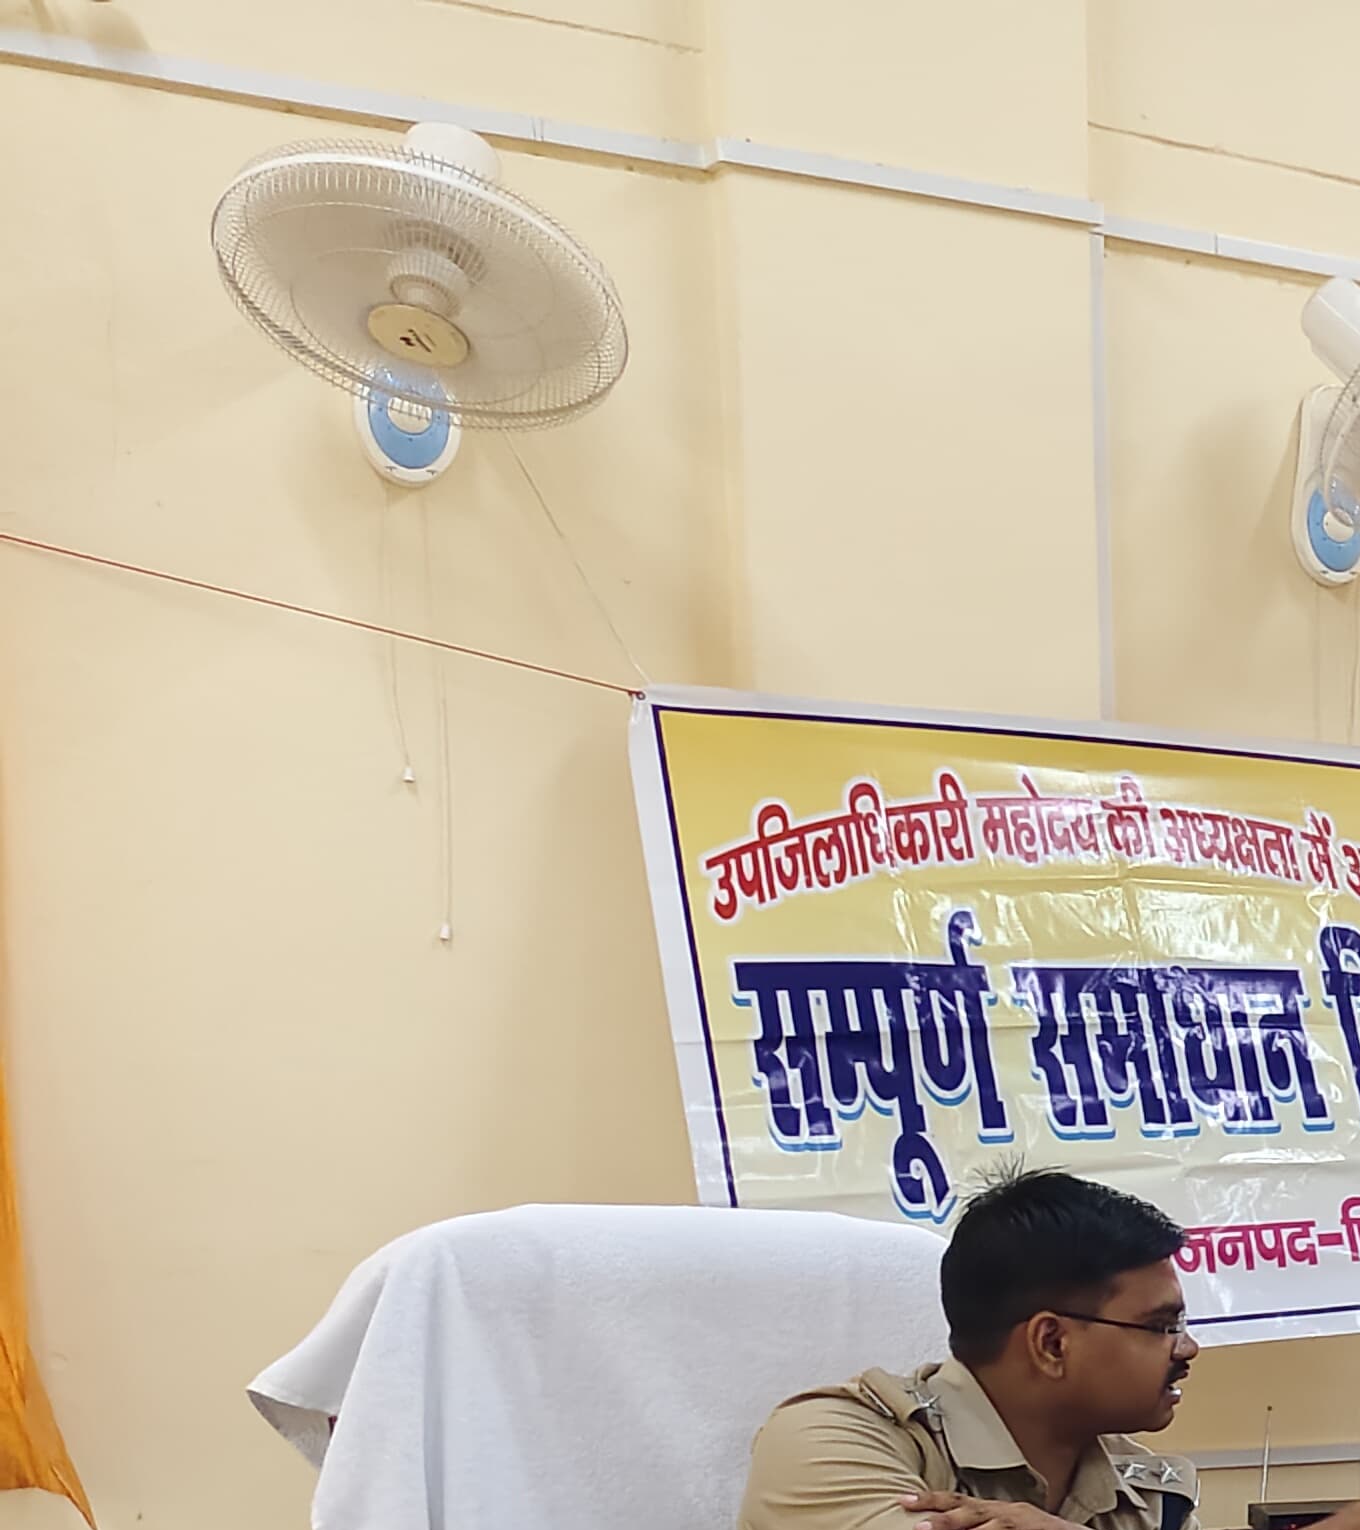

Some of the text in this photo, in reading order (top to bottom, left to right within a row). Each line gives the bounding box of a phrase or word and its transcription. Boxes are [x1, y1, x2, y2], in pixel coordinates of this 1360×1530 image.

[706, 773, 976, 920] उपजिलाधिकारी
[976, 773, 1099, 863] महोदय
[1159, 807, 1303, 881] अध्यक्षता
[1301, 811, 1338, 890] में
[733, 909, 1013, 1219] सम्पूर्ण
[1010, 960, 1336, 1139] समाधान
